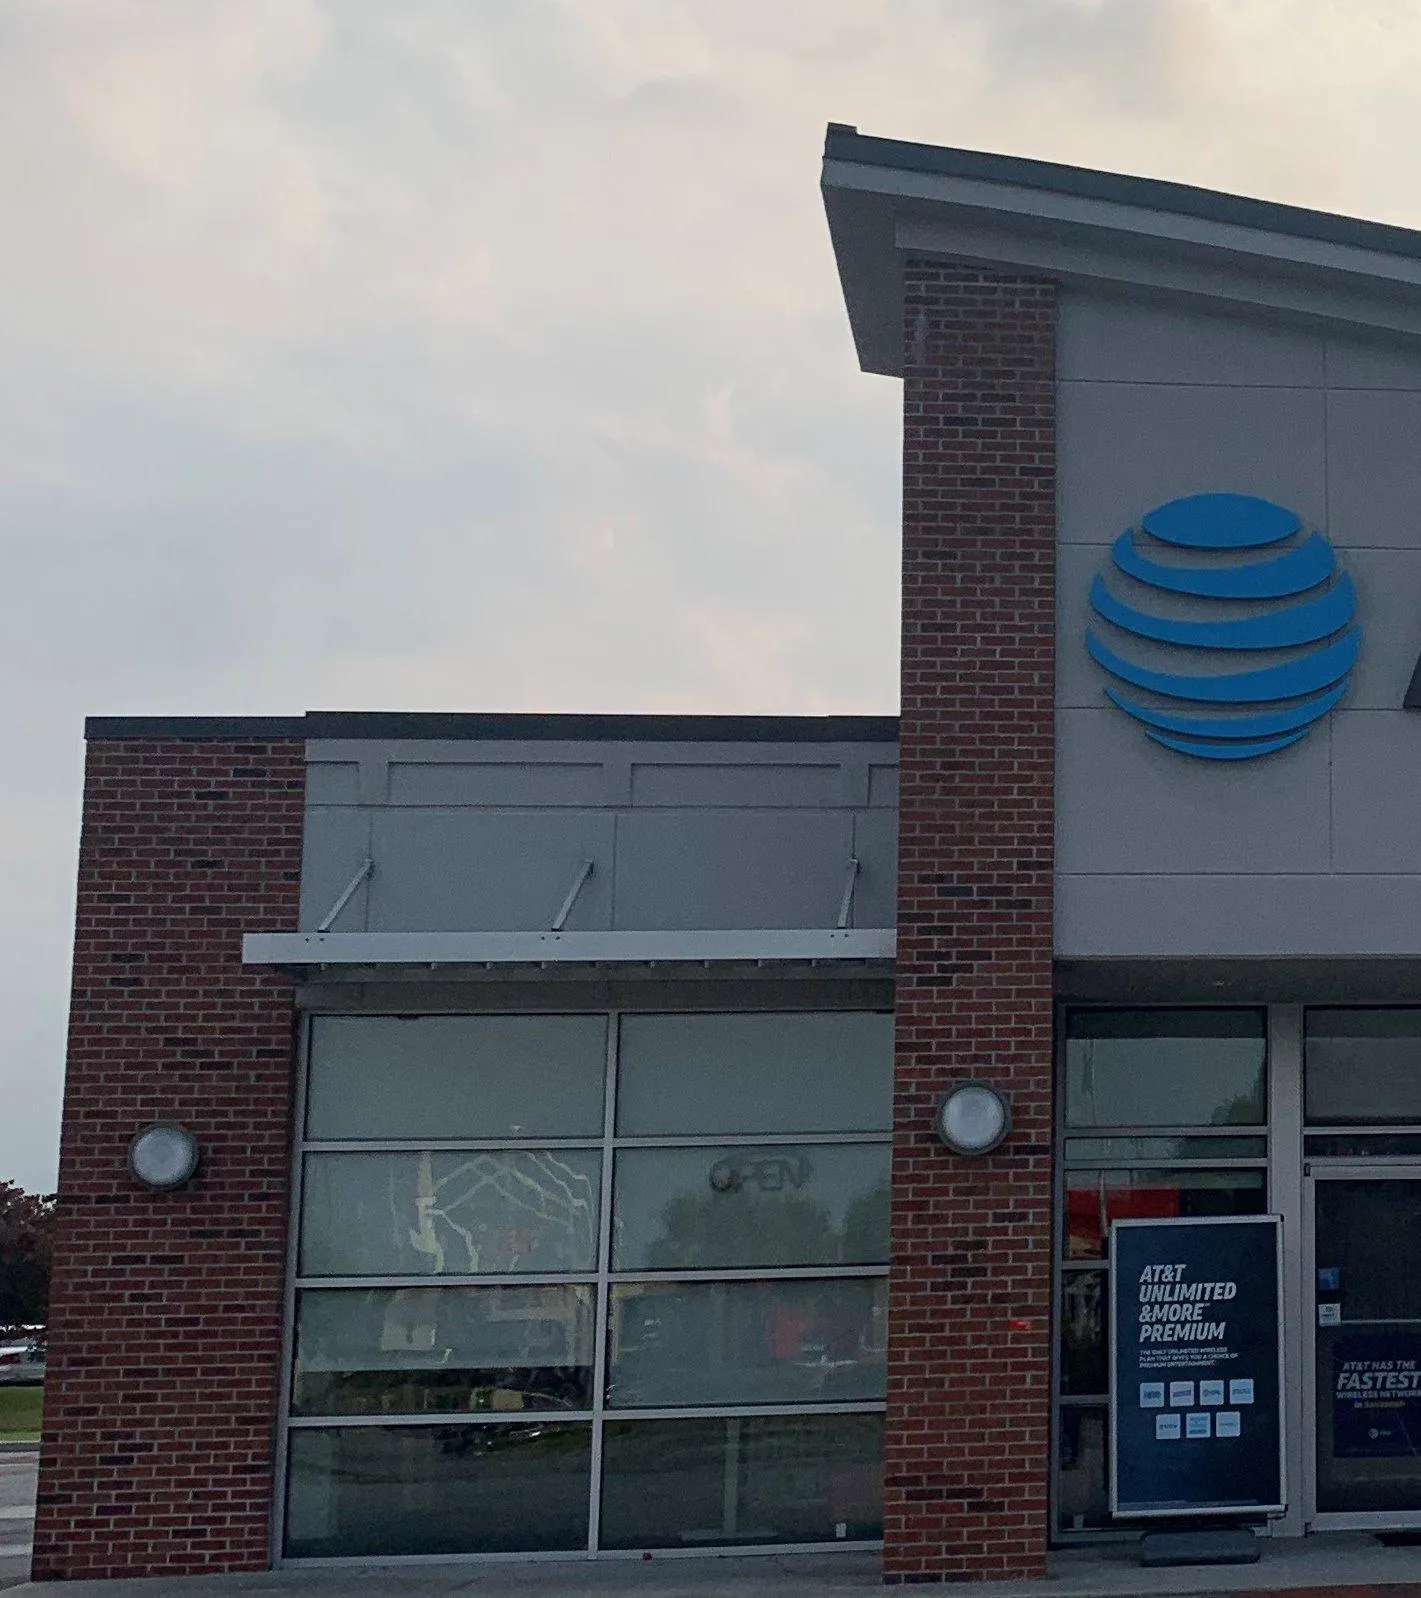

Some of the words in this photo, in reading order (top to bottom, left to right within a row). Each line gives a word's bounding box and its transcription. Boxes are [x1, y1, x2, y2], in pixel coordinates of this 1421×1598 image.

[1139, 1264, 1187, 1283] AT&T
[1139, 1282, 1237, 1303] UNLIMITED
[1139, 1321, 1227, 1343] PREMIUM
[1342, 1361, 1371, 1371] AT&T
[1372, 1360, 1394, 1370] HAS
[1396, 1360, 1418, 1370] THE
[1335, 1390, 1379, 1400] WIRELESS
